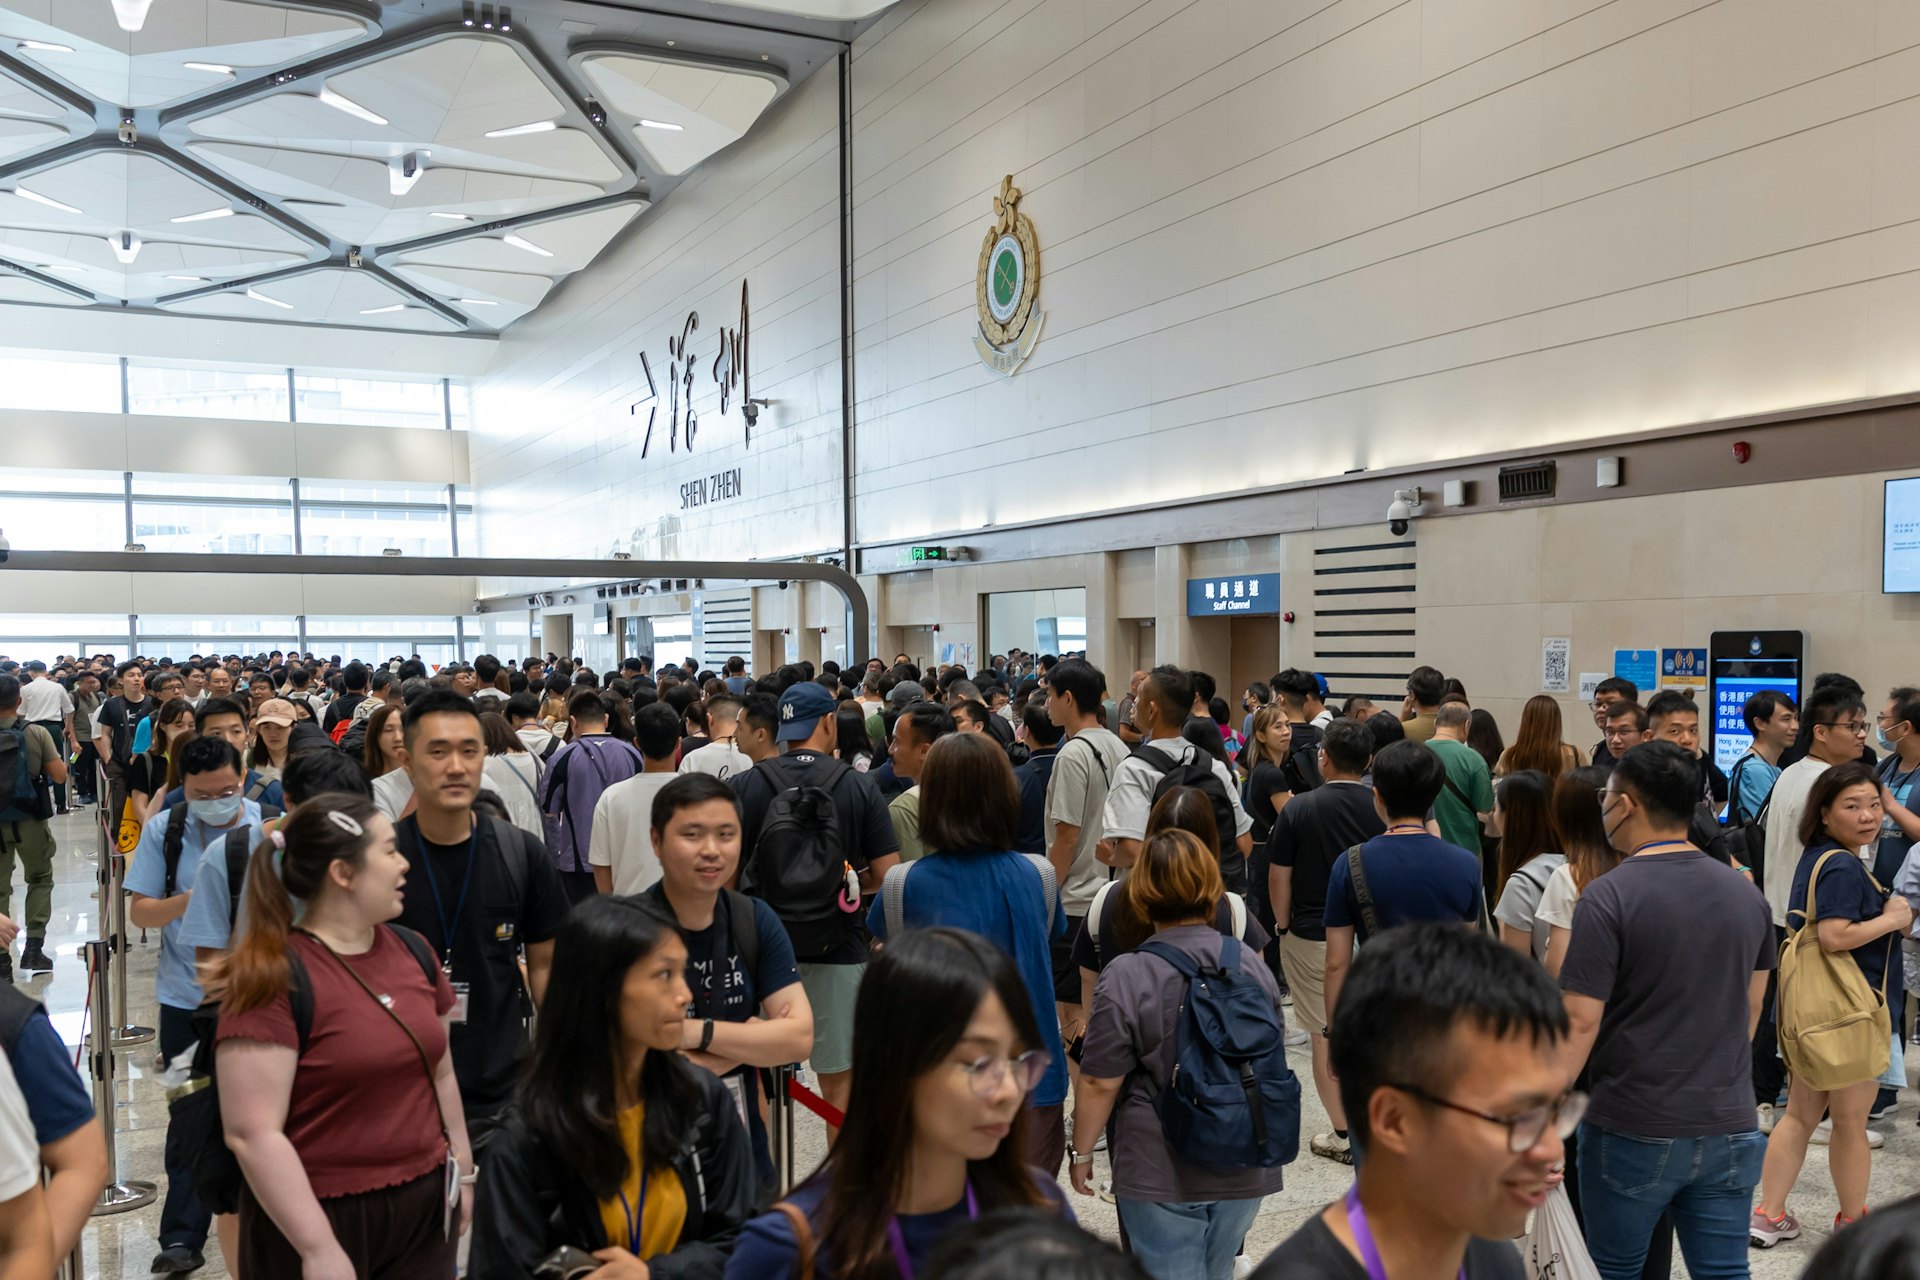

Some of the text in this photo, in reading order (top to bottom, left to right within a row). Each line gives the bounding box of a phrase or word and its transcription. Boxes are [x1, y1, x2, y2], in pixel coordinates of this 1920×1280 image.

[680, 467, 741, 510] SHEN ZHEN
[1205, 579, 1260, 599] 職員通道
[1213, 600, 1250, 611] Staff Channel
[783, 703, 794, 720] NY
